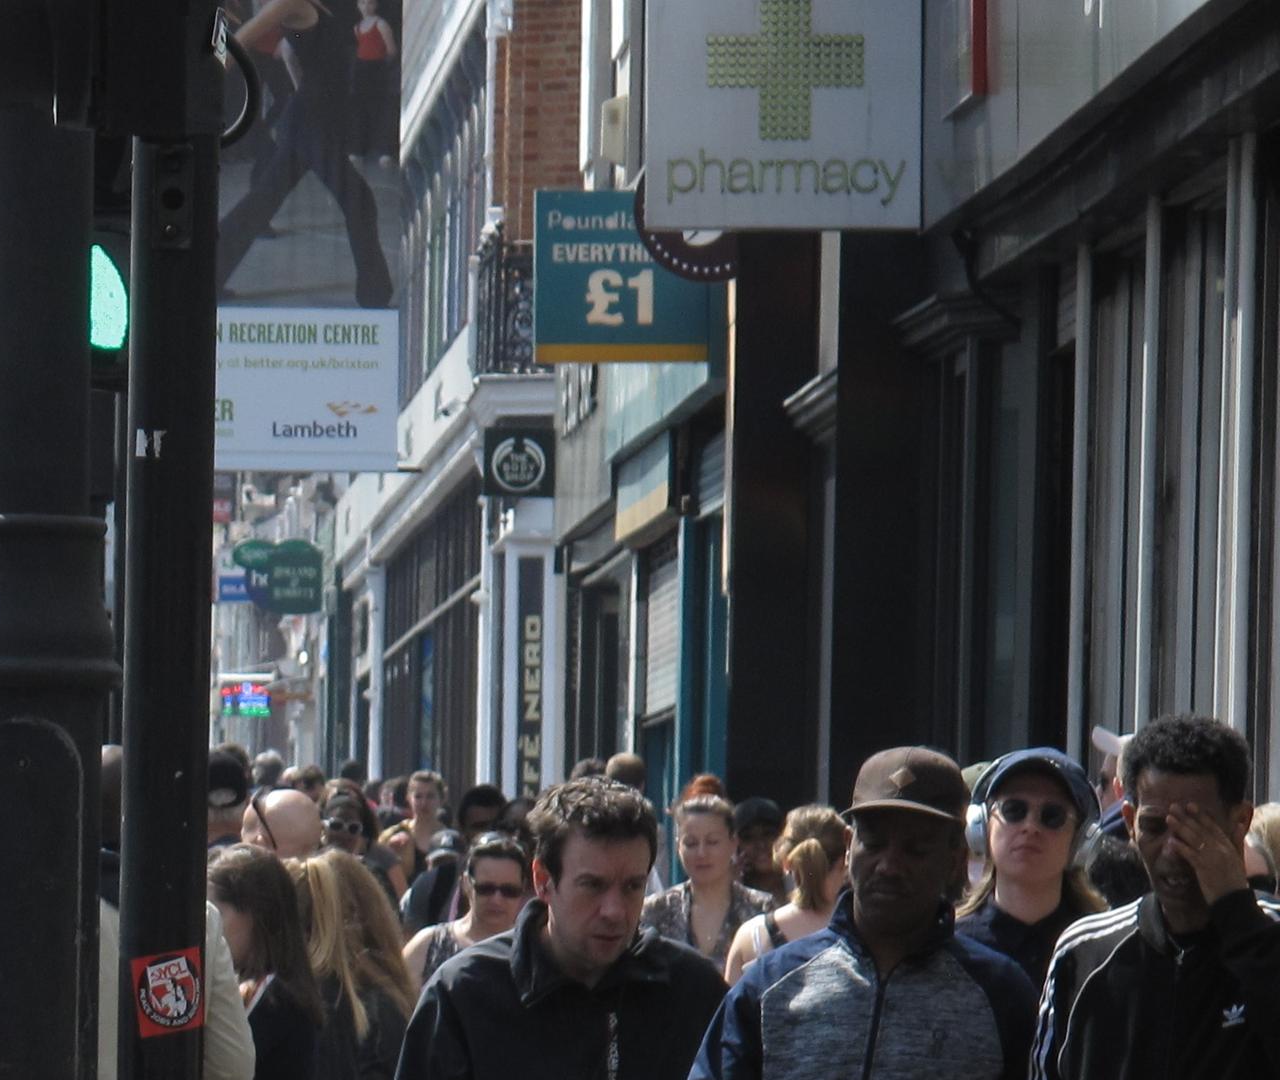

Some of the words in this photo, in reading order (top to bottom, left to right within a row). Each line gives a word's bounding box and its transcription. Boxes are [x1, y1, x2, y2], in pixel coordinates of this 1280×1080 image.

[666, 147, 906, 206] pharmacy
[585, 269, 654, 326] £1
[229, 323, 317, 345] RECREATION
[323, 324, 379, 345] CENTRE
[244, 357, 378, 371] better.org.uk/brixton
[272, 421, 357, 438] Lambeth
[525, 615, 540, 720] NERO
